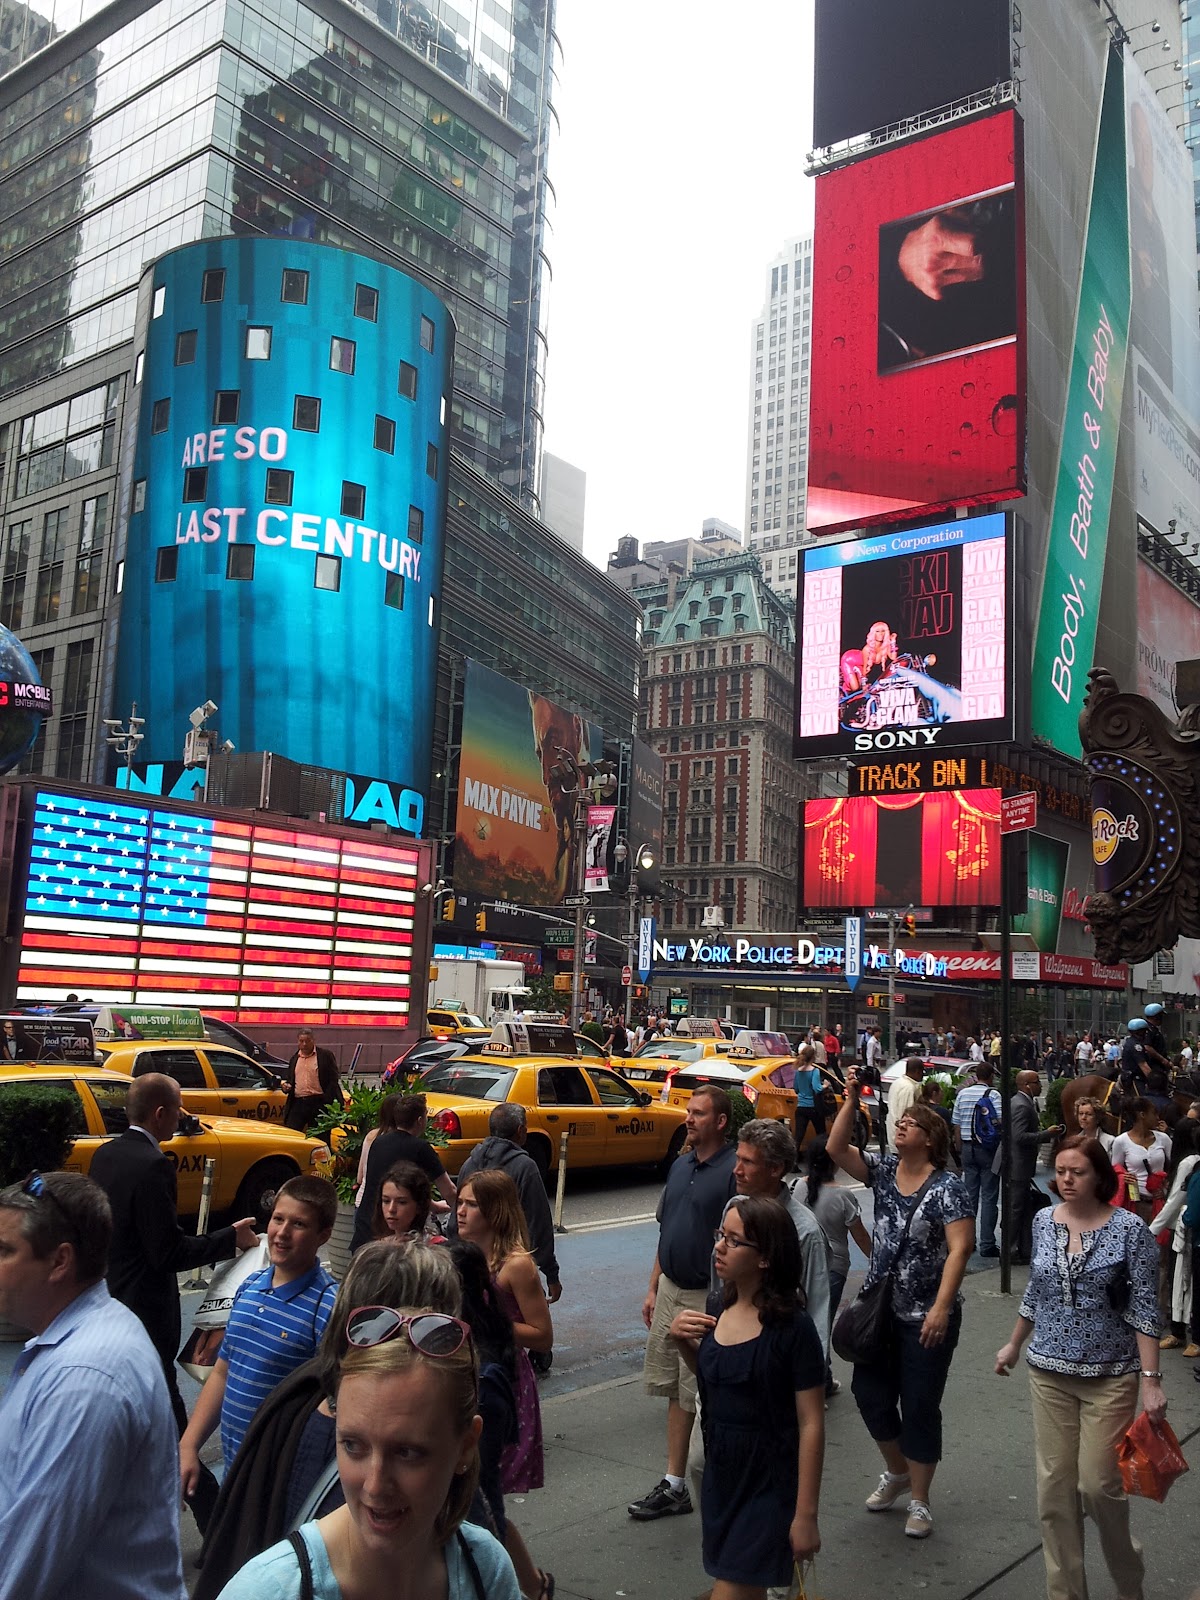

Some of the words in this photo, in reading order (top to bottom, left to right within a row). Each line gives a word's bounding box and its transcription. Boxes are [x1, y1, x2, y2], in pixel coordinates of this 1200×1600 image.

[1086, 303, 1115, 412] Baby
[1083, 412, 1101, 450] &
[182, 429, 227, 468] ARE
[234, 426, 288, 462] SO
[1069, 453, 1097, 560] Bath
[176, 507, 246, 544] LAST
[256, 509, 422, 583] CENTURY.
[857, 543, 888, 557] News
[891, 528, 964, 551] Corporation
[14, 683, 51, 701] MOBILE
[880, 687, 916, 708] VIVA
[876, 705, 919, 726] GLAM
[854, 727, 942, 751] SONY
[635, 763, 660, 796] MAGIC
[857, 761, 921, 792] TRACK
[932, 758, 966, 786] BIN
[464, 776, 501, 817] MAX
[501, 790, 543, 831] PAYNE
[1002, 802, 1010, 811] NO
[1011, 795, 1034, 808] STANDING
[1006, 805, 1031, 819] ANYTIME
[1100, 814, 1139, 843] Rock
[1095, 845, 1108, 855] CAFE
[803, 918, 835, 926] SHERWOOD
[642, 919, 650, 968] NYPD
[652, 938, 687, 962] NEW
[690, 938, 731, 963] YORK
[736, 938, 793, 964] POLICE
[849, 919, 857, 974] NYPD
[1044, 955, 1084, 979] Walgreens
[1091, 961, 1126, 984] Walgreens
[130, 1015, 171, 1026] NON-STOP
[43, 1036, 60, 1048] food
[60, 1036, 90, 1050] STAR
[256, 1101, 286, 1121] TAX
